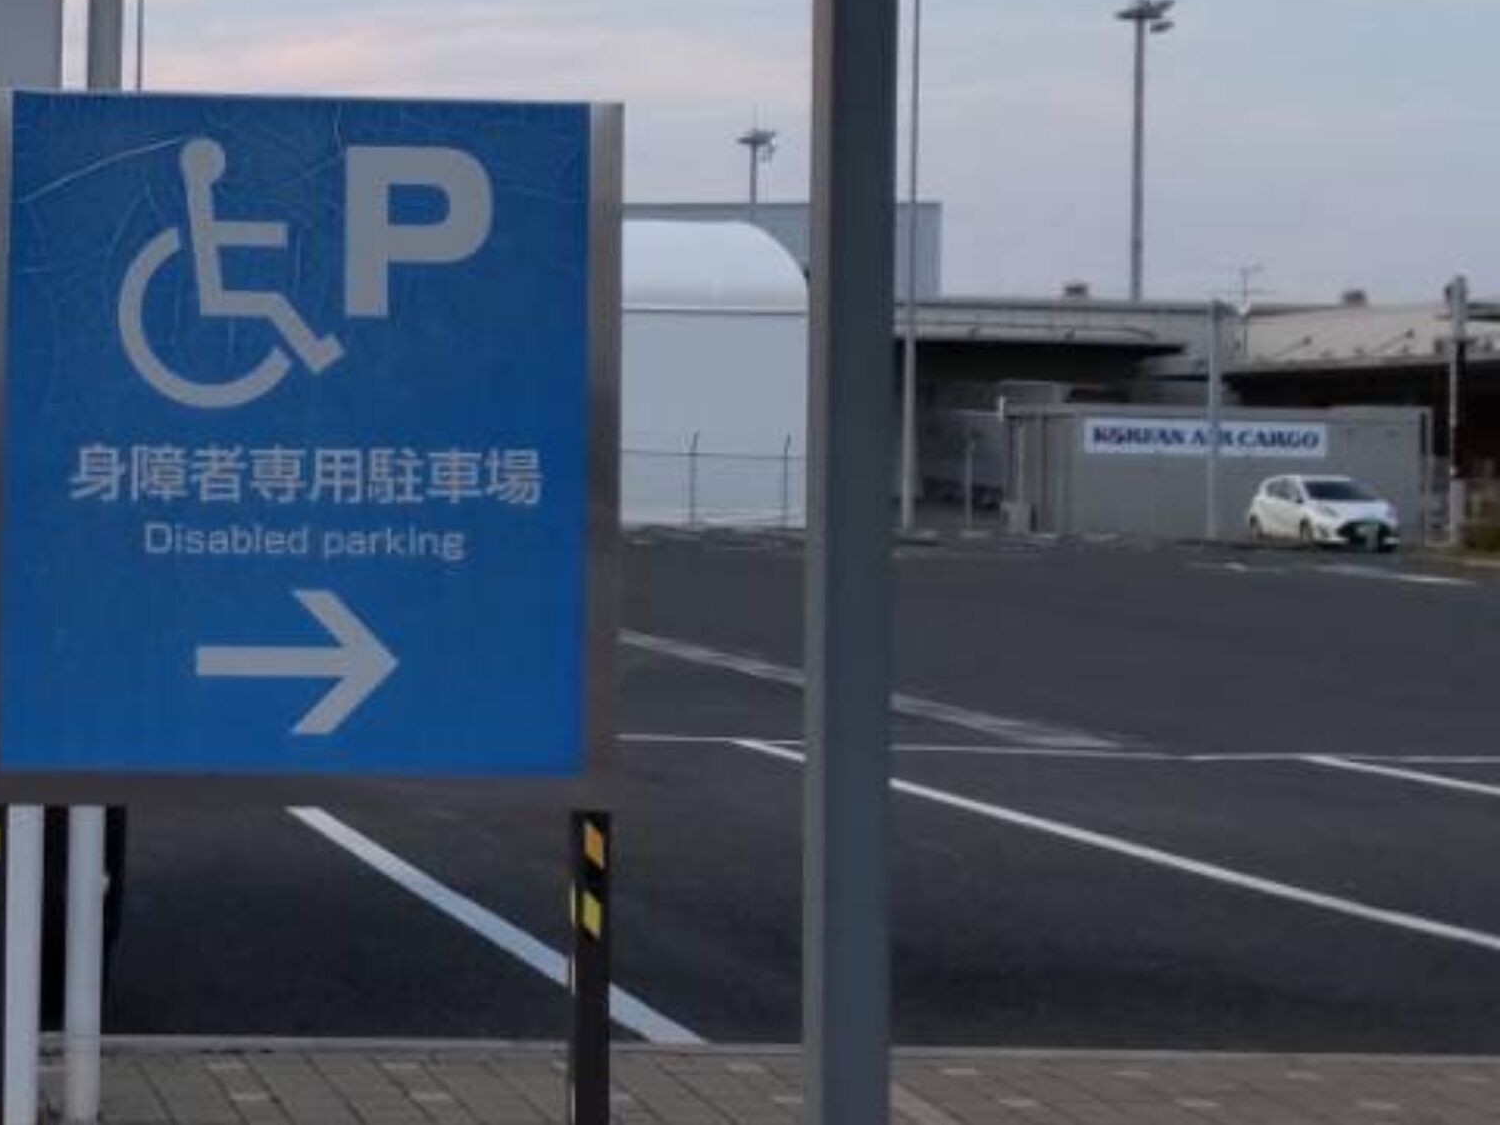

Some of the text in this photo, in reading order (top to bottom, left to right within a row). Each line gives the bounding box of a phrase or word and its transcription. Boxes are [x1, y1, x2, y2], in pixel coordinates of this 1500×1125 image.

[344, 145, 493, 317] P
[1236, 431, 1320, 449] CARGO
[69, 443, 543, 506] 身障者専用駐車場
[144, 521, 467, 562] Disabled parking
